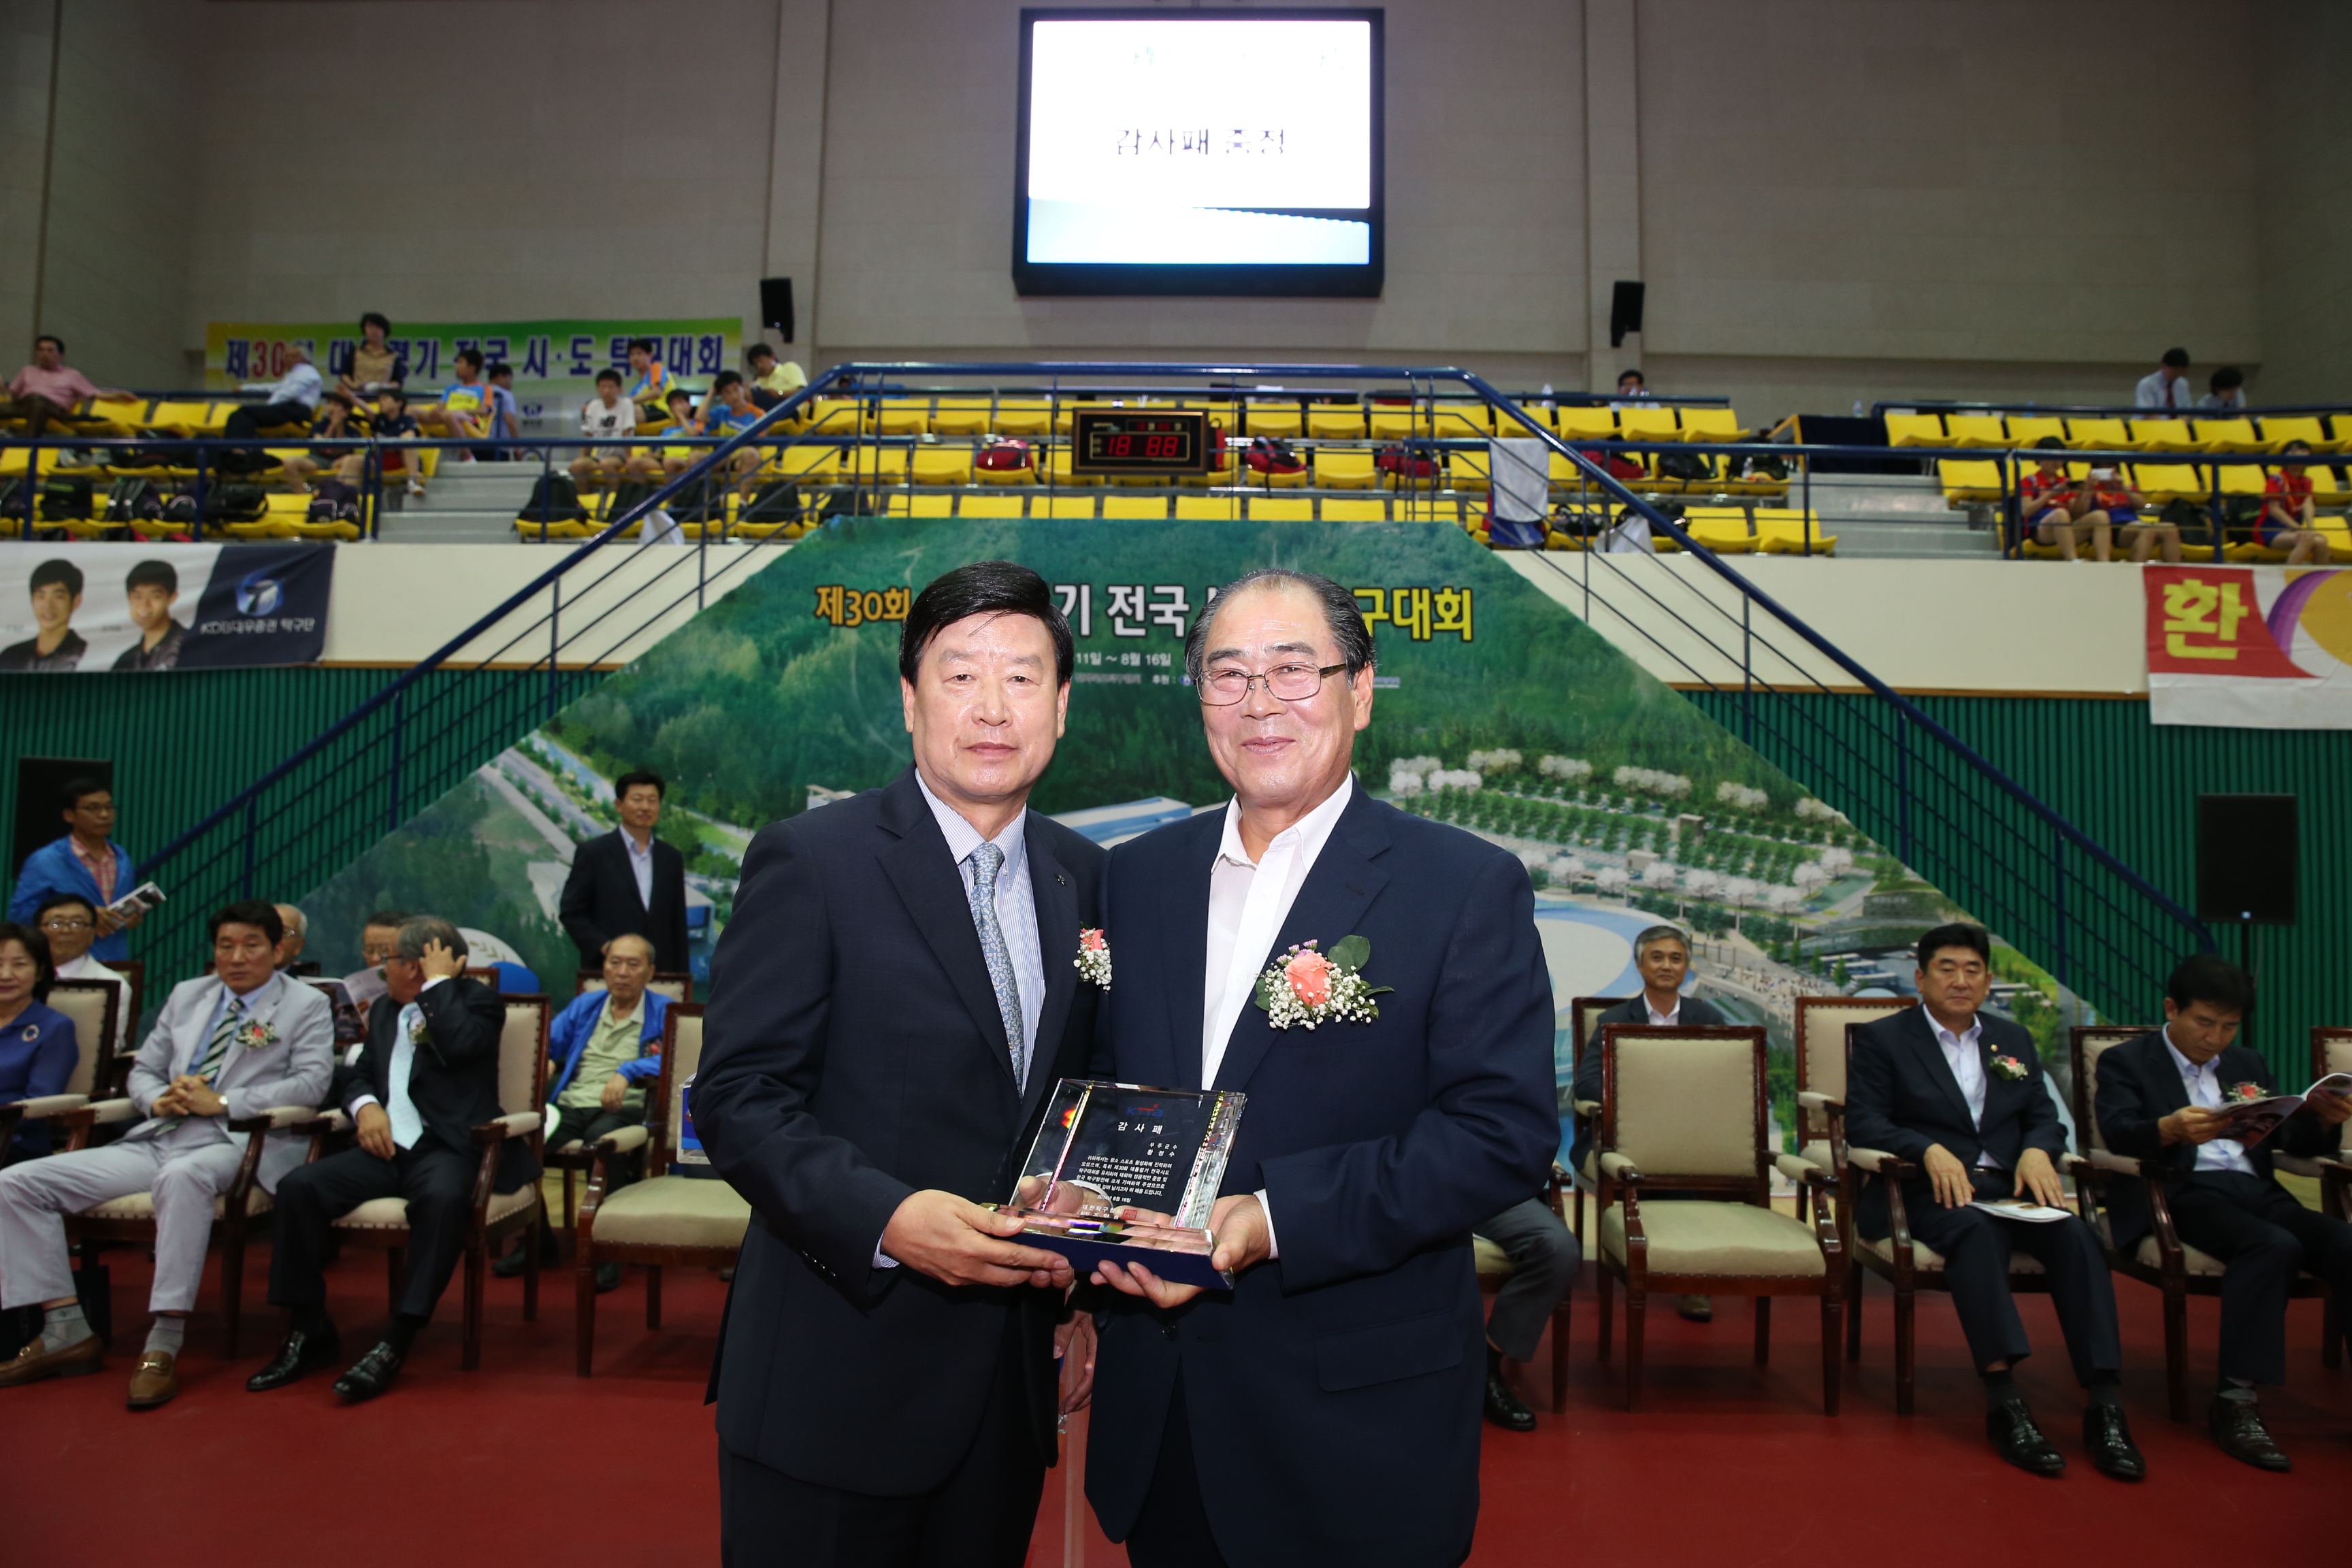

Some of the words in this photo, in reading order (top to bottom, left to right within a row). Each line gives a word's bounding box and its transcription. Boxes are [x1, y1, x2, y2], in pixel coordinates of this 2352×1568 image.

[1117, 129, 1209, 155] 감사패
[226, 338, 314, 379] 제30
[815, 585, 911, 626] 제30회
[1107, 585, 1190, 638] 전국
[1353, 587, 1472, 640] 구대회
[1076, 652, 1102, 666] 11일
[1120, 652, 1141, 666] 8월
[1146, 653, 1171, 667] 16일
